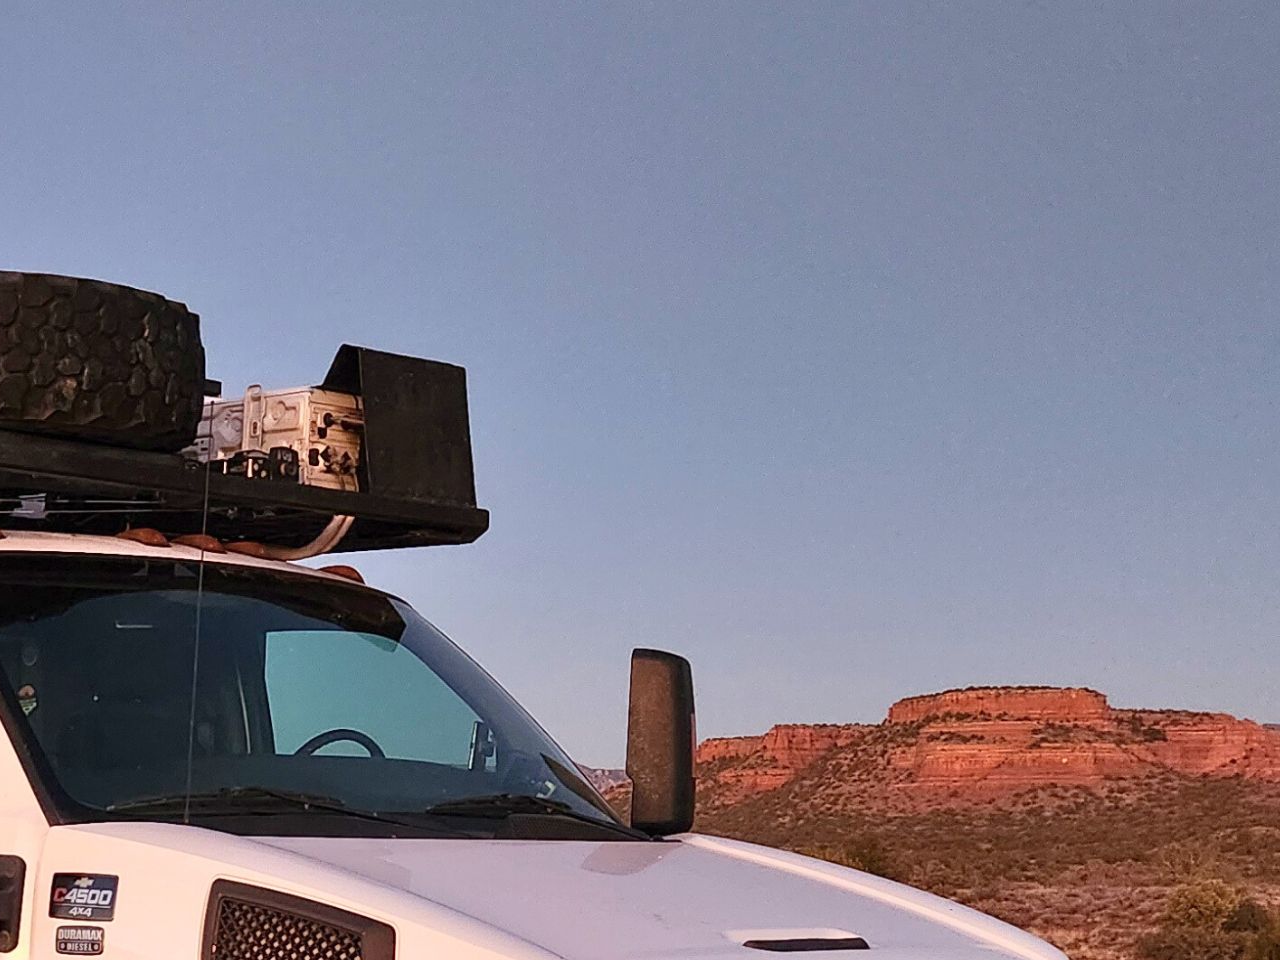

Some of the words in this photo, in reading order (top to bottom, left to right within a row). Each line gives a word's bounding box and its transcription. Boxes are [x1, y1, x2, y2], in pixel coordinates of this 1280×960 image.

[53, 888, 113, 905] C4500
[58, 929, 103, 941] DURAMAX
[66, 943, 93, 952] DIESEL
